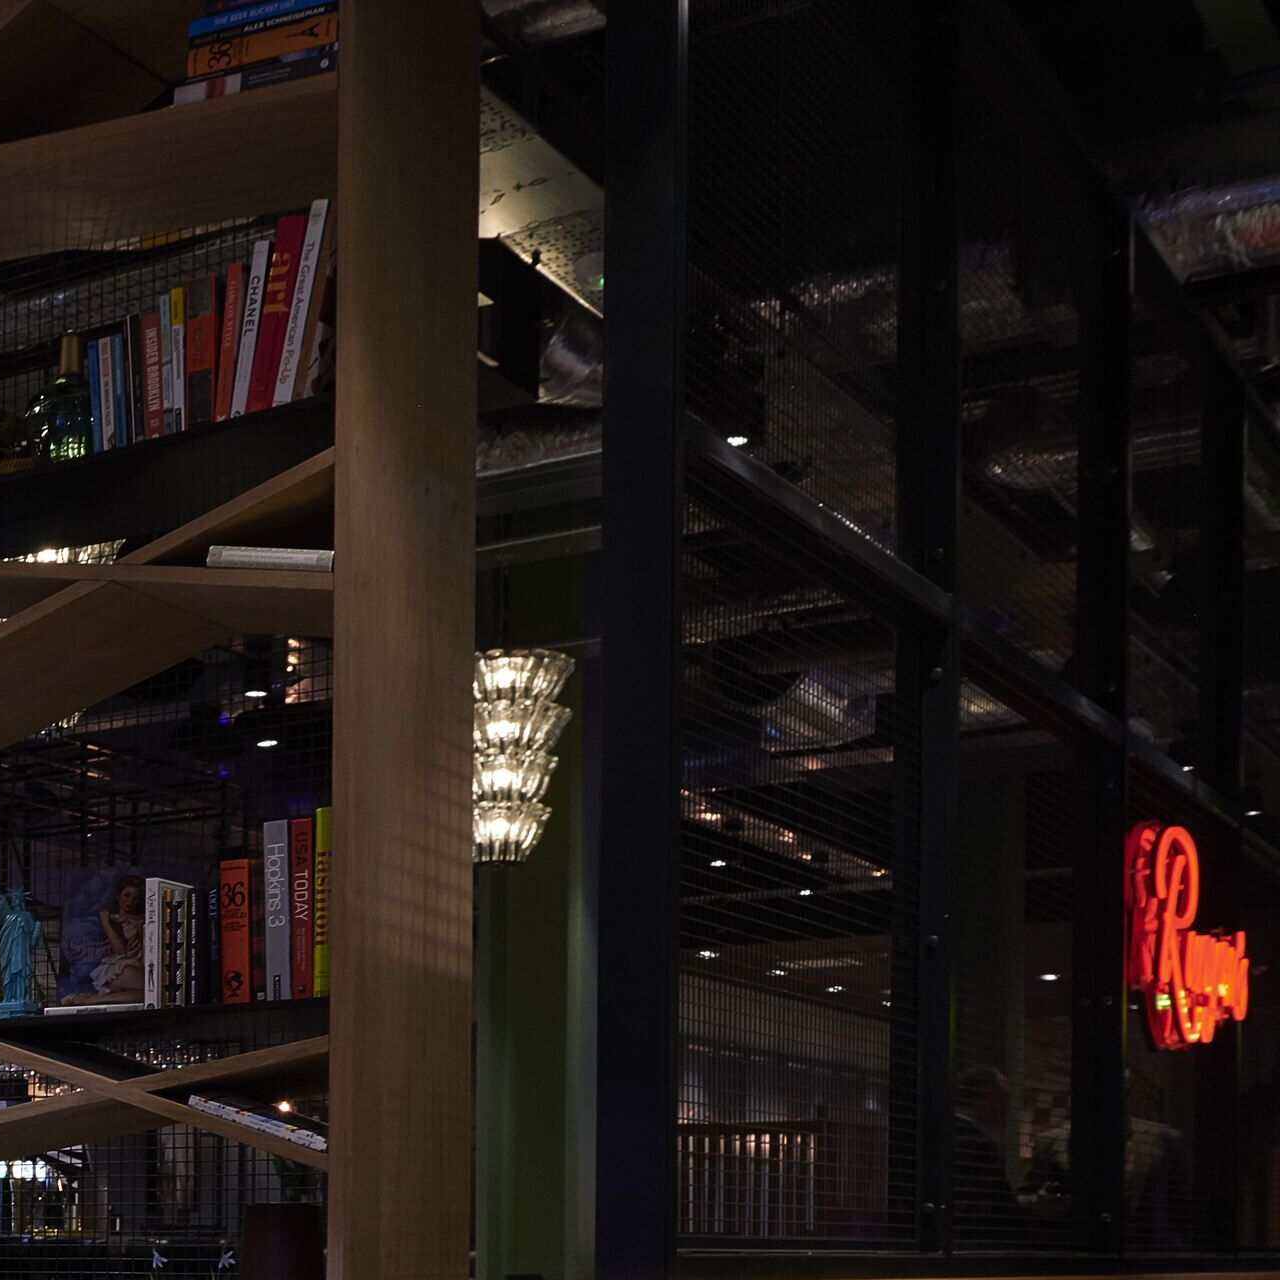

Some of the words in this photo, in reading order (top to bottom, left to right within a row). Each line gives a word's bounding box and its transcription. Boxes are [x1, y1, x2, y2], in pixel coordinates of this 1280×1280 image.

[306, 240, 316, 262] The
[262, 252, 291, 314] art
[298, 264, 311, 296] Great
[243, 274, 261, 337] CHANEL
[288, 297, 306, 347] American
[144, 327, 160, 365] INSIDER
[278, 347, 296, 385] Pin-Up
[146, 365, 161, 412] BROOKLYN
[294, 831, 309, 867] USA
[221, 880, 246, 909] 36
[265, 842, 286, 911] Hopkins
[294, 869, 309, 922] TODAY
[207, 887, 218, 918] VOGUE
[268, 914, 286, 929] 3
